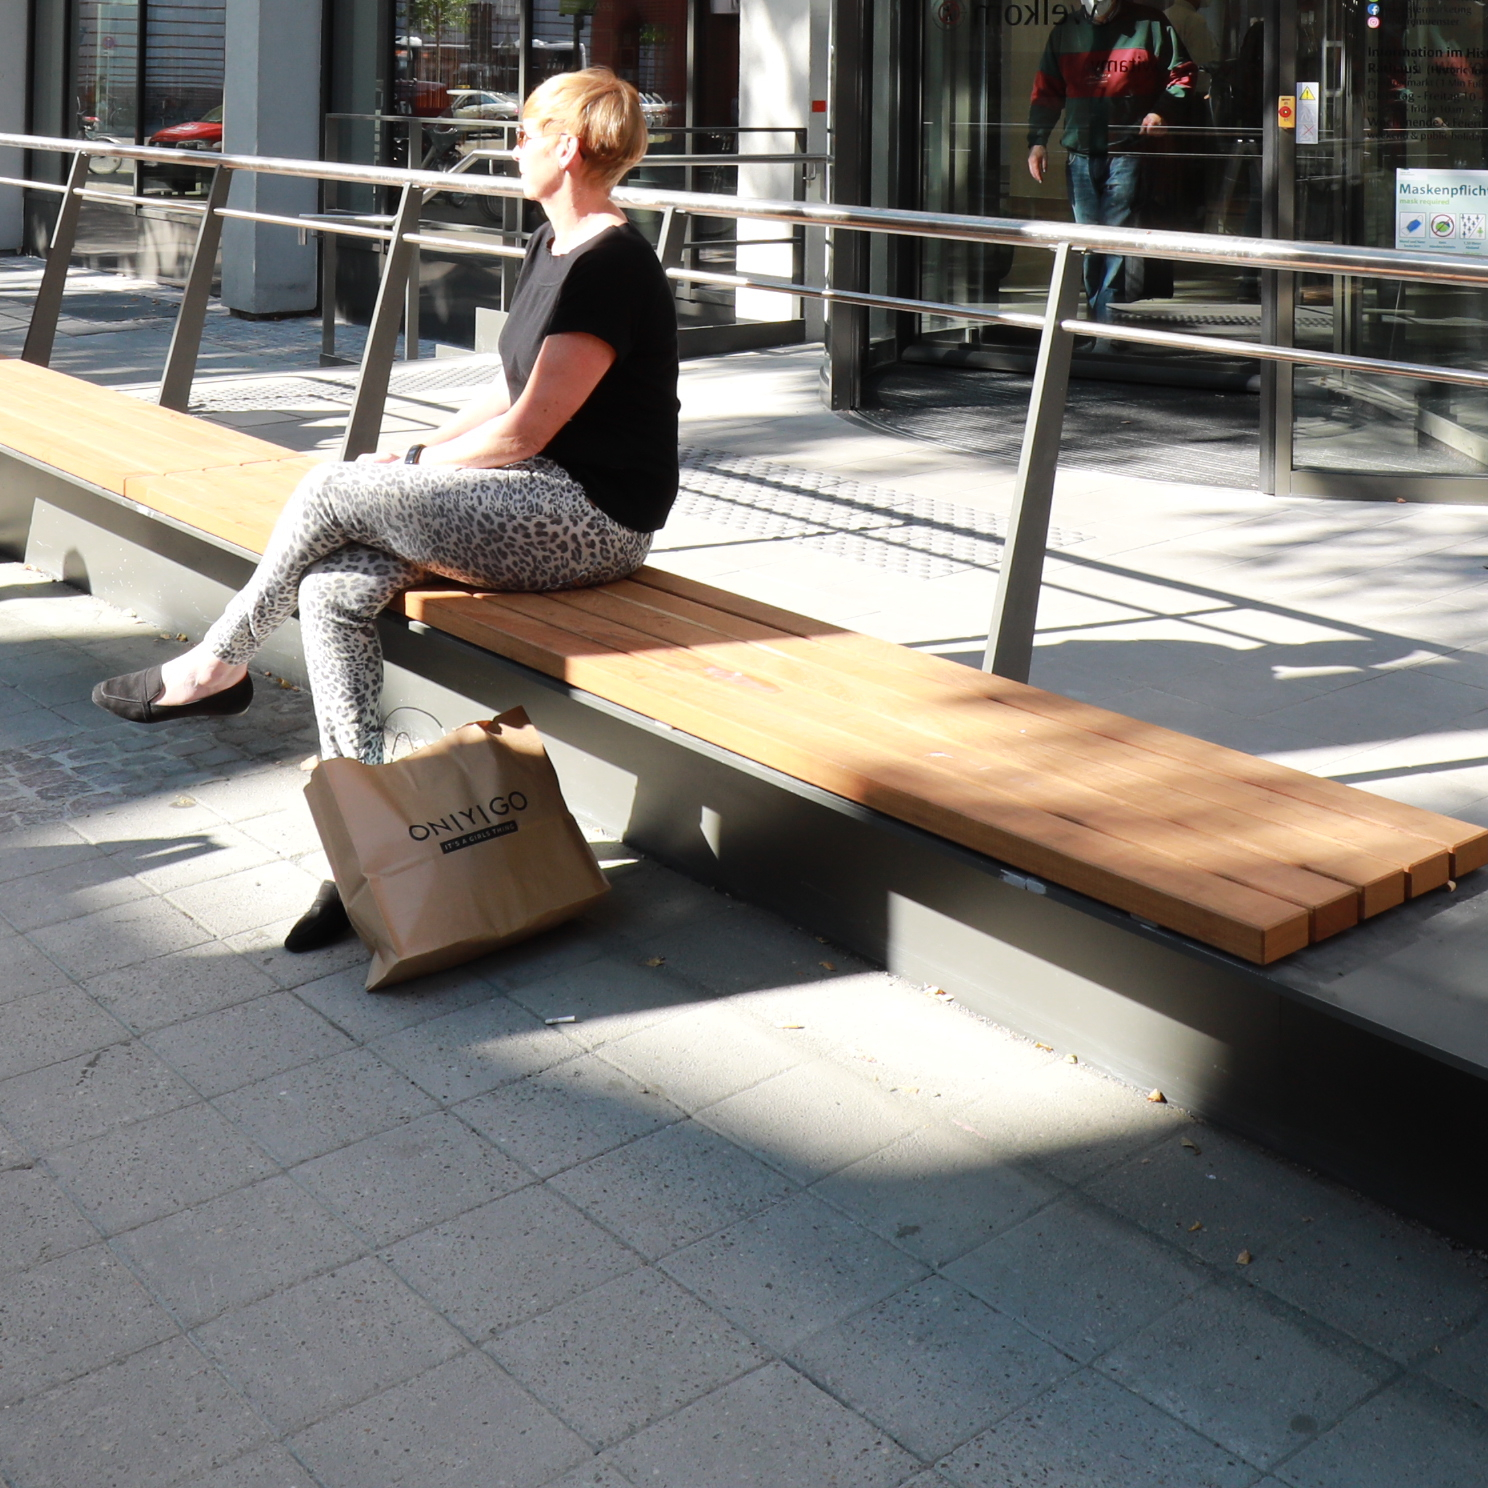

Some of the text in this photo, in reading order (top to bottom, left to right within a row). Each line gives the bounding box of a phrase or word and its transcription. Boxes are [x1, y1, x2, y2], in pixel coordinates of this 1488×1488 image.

[1447, 47, 1463, 57] im
[1420, 198, 1450, 206] required
[469, 831, 491, 843] GIRLS
[492, 823, 516, 835] THING
